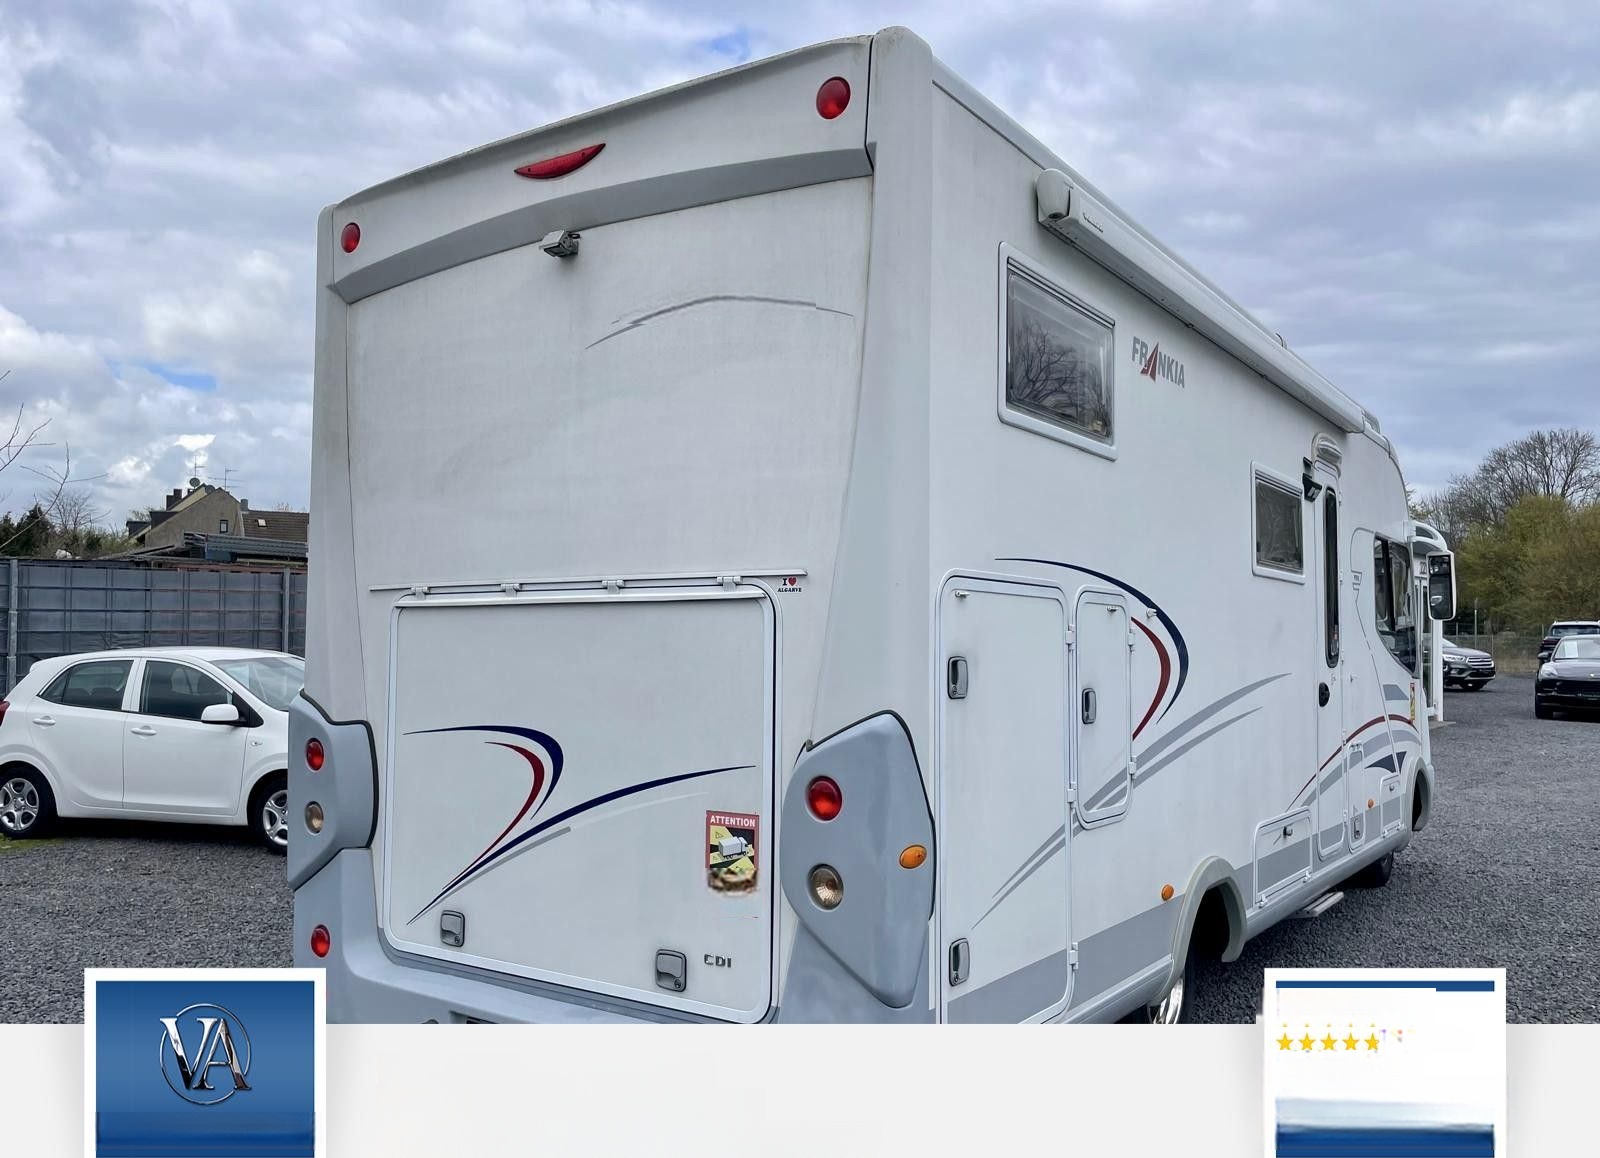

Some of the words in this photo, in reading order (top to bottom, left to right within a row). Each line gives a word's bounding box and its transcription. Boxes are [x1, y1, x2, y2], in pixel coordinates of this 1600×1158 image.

[1131, 335, 1185, 389] FRANKIA
[710, 815, 756, 827] ATTENTION
[703, 953, 732, 968] CDI
